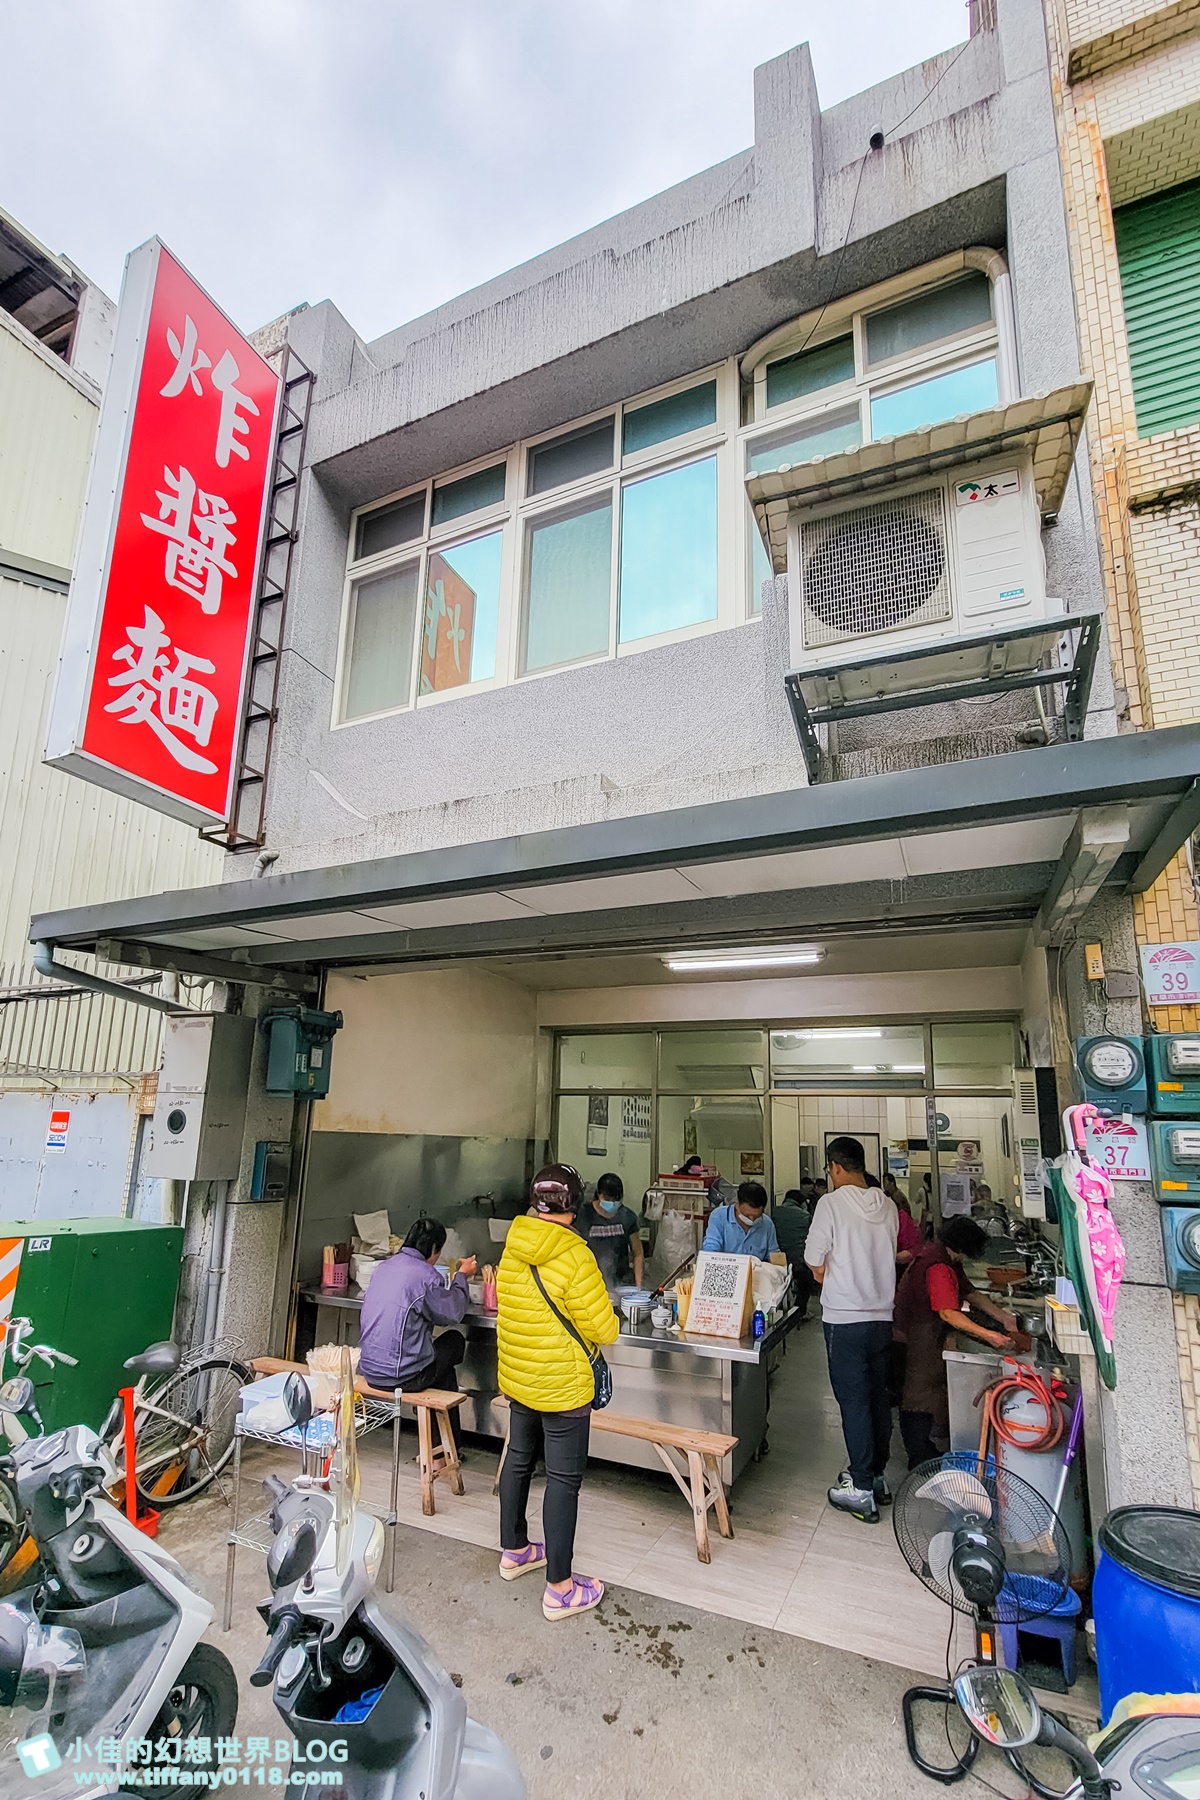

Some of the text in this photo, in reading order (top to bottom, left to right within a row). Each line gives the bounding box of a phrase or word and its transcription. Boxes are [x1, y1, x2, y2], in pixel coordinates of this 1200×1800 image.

[984, 482, 1017, 498] 太一
[104, 313, 260, 775] 炸醬麵
[1161, 971, 1189, 992] 39
[308, 1073, 315, 1087] 5
[48, 1134, 66, 1142] SECOM
[1104, 1145, 1129, 1166] 37
[31, 1239, 50, 1250] LR
